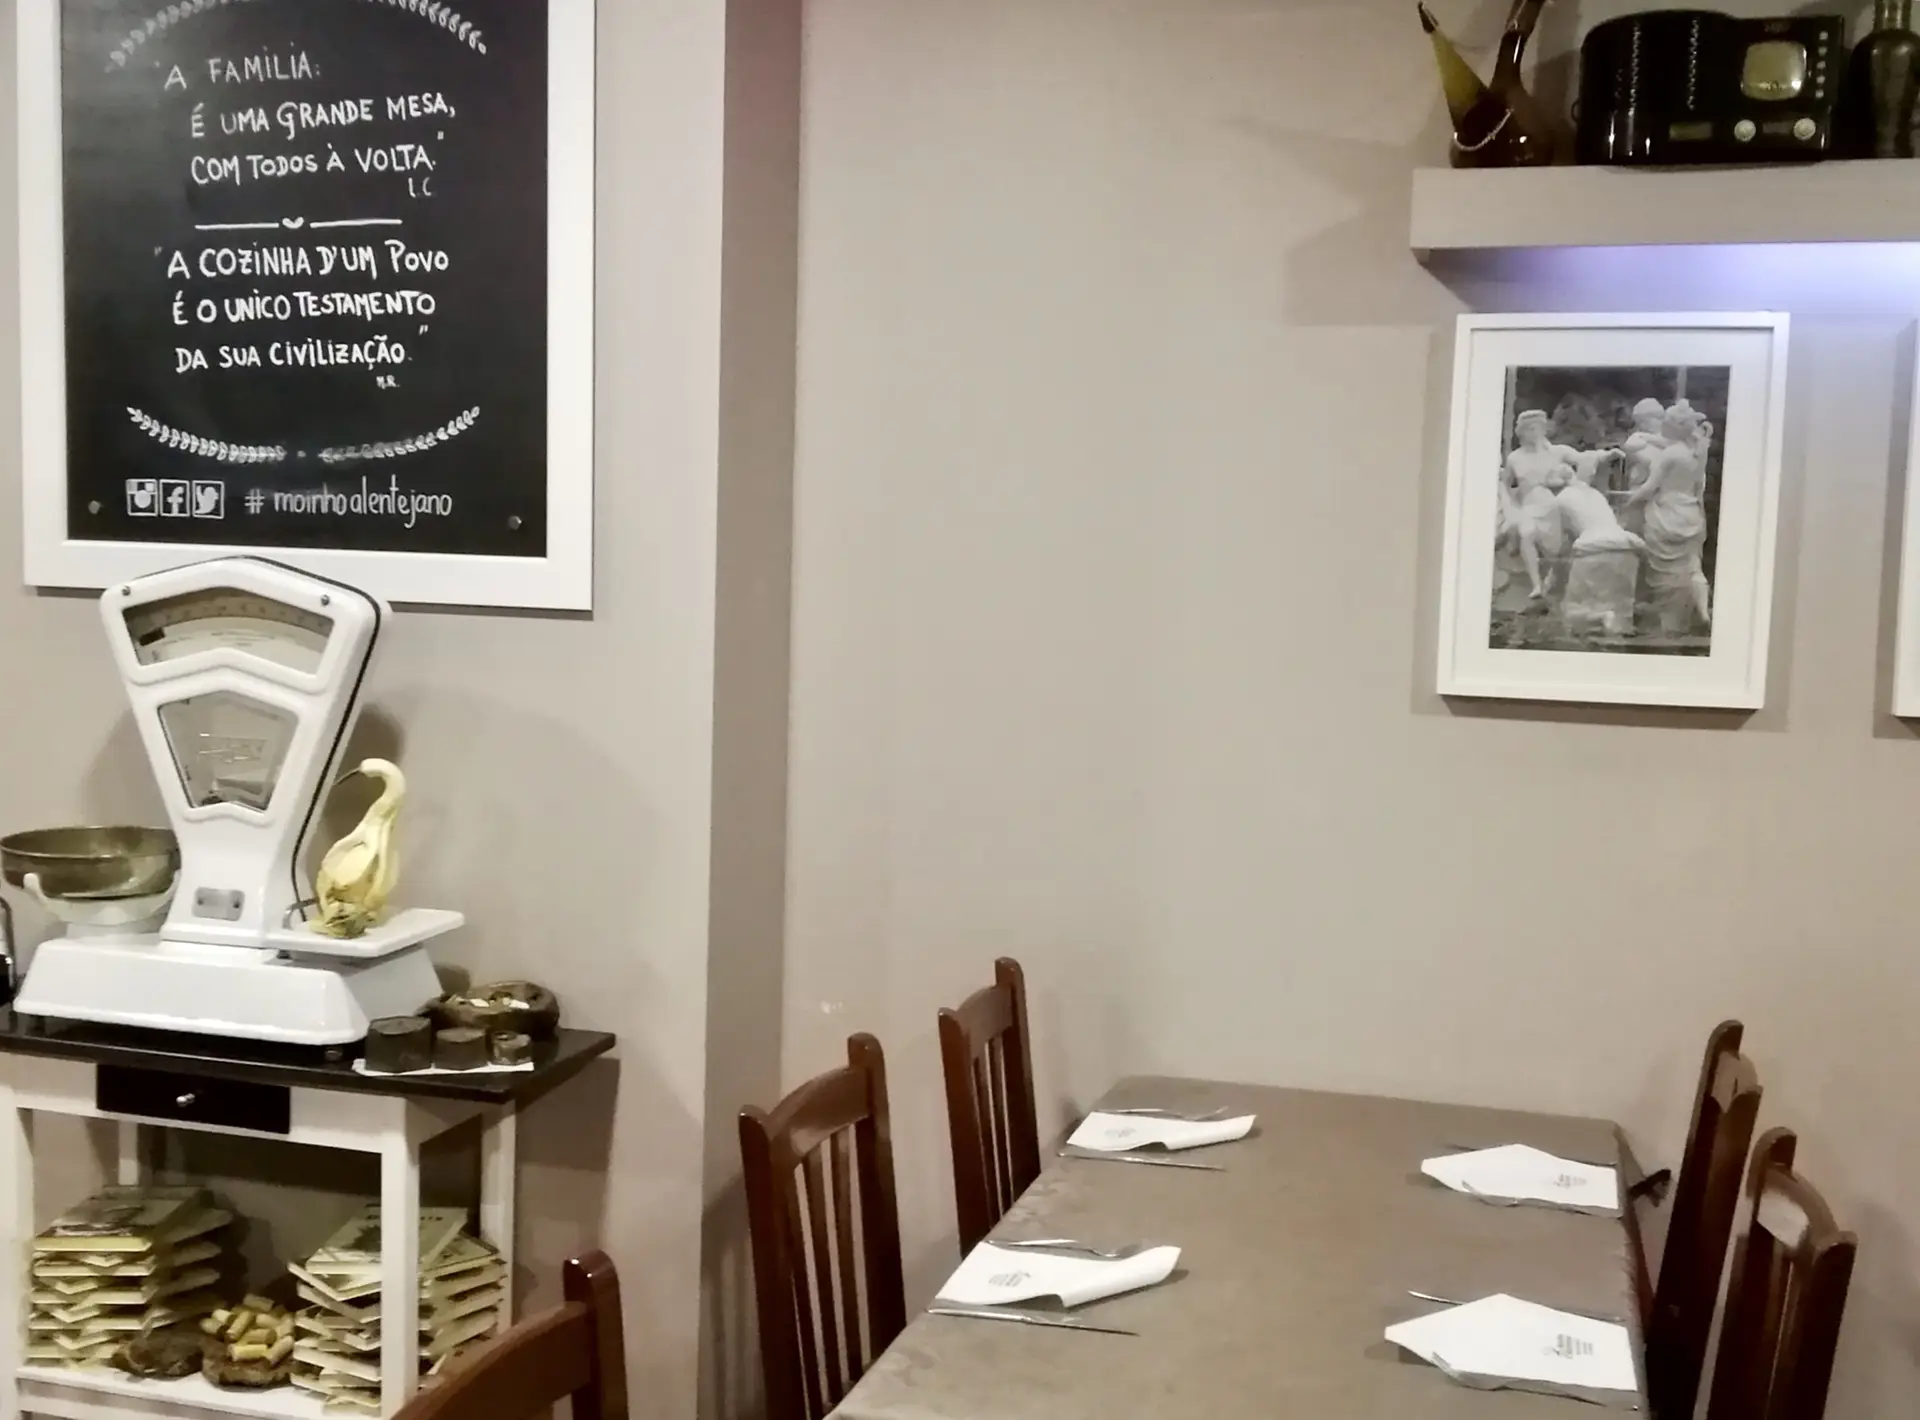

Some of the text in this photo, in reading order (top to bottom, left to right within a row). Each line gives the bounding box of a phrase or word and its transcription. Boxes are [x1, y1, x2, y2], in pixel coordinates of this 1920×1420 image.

[190, 92, 456, 140] É UMA GRANDE MESA,
[190, 154, 241, 186] COM
[246, 154, 318, 179] TODOS
[326, 143, 345, 173] À
[199, 242, 312, 277] COZINHA
[172, 288, 437, 325] É O UNICO TESTAMENTO
[174, 346, 209, 374] DA
[218, 344, 262, 369] SUA
